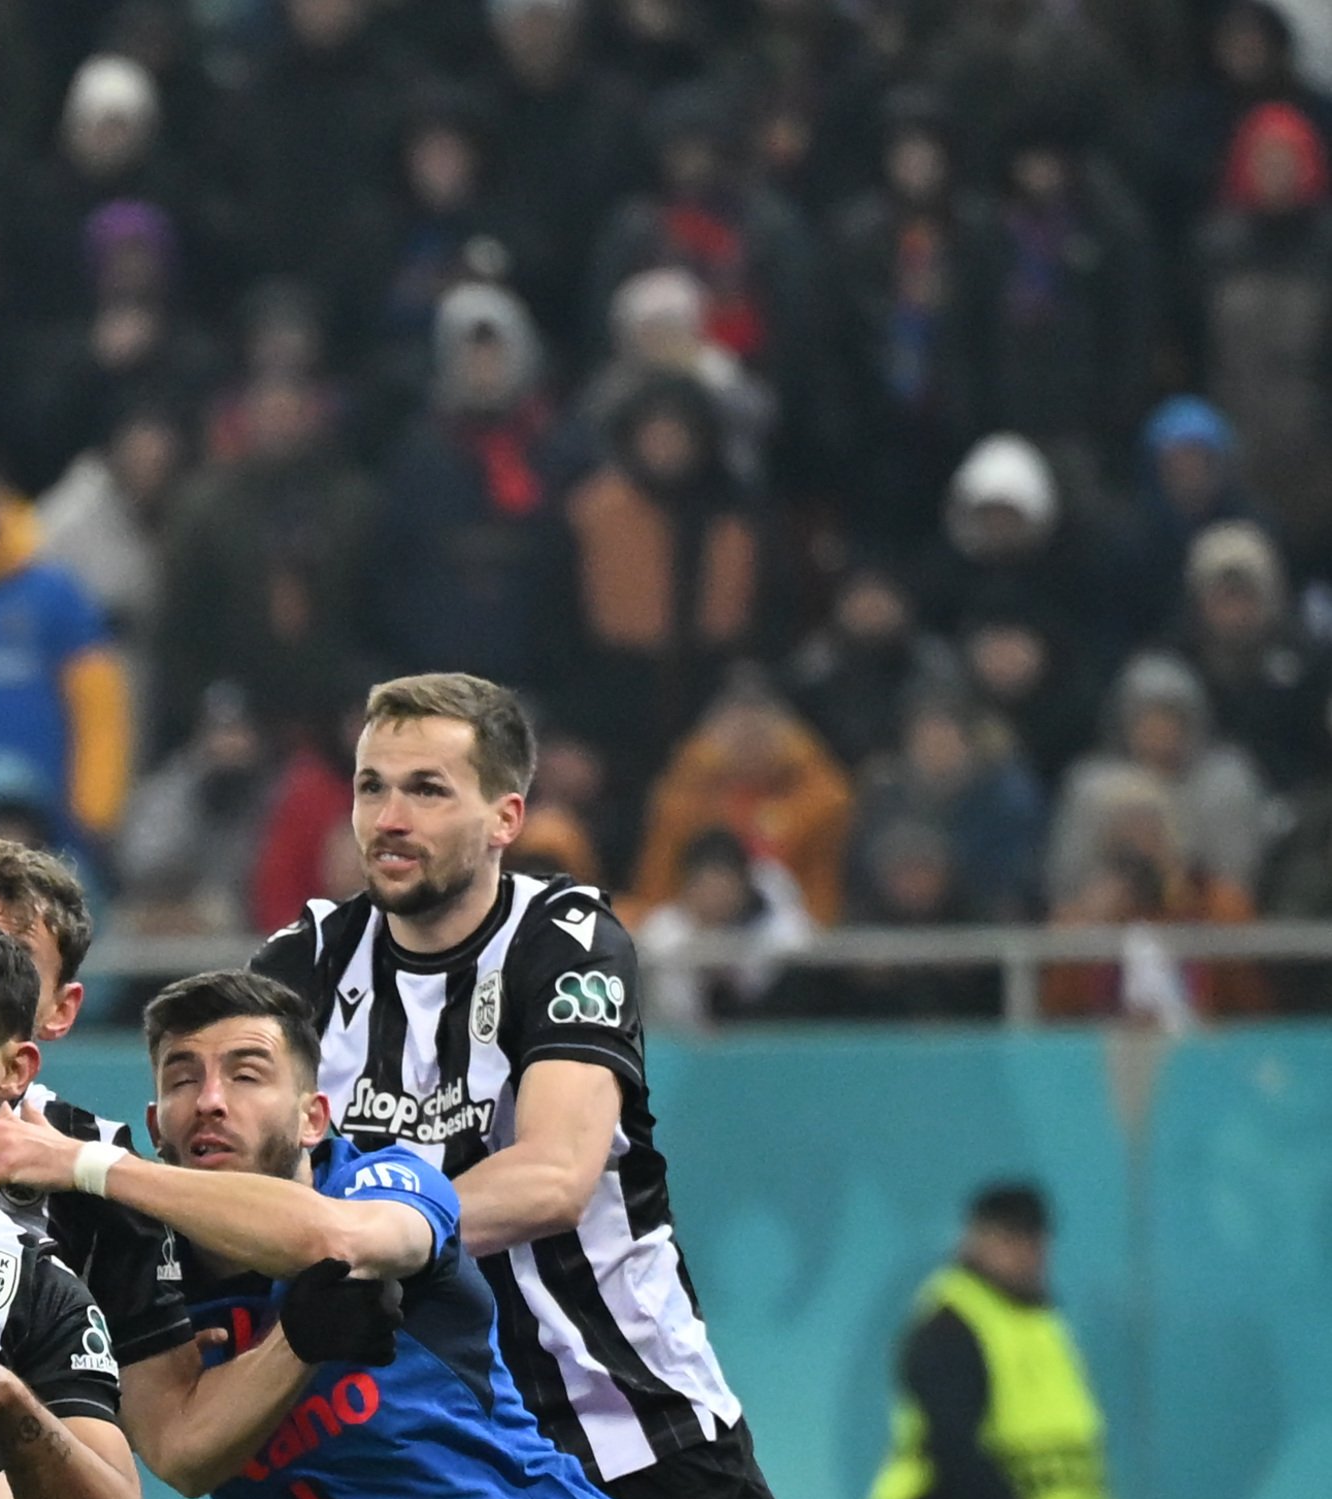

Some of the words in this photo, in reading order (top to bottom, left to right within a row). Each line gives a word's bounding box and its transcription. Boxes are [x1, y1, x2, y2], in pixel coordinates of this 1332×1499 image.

[347, 1078, 418, 1134] Stop
[423, 1077, 462, 1116] child
[416, 1103, 492, 1142] obesity
